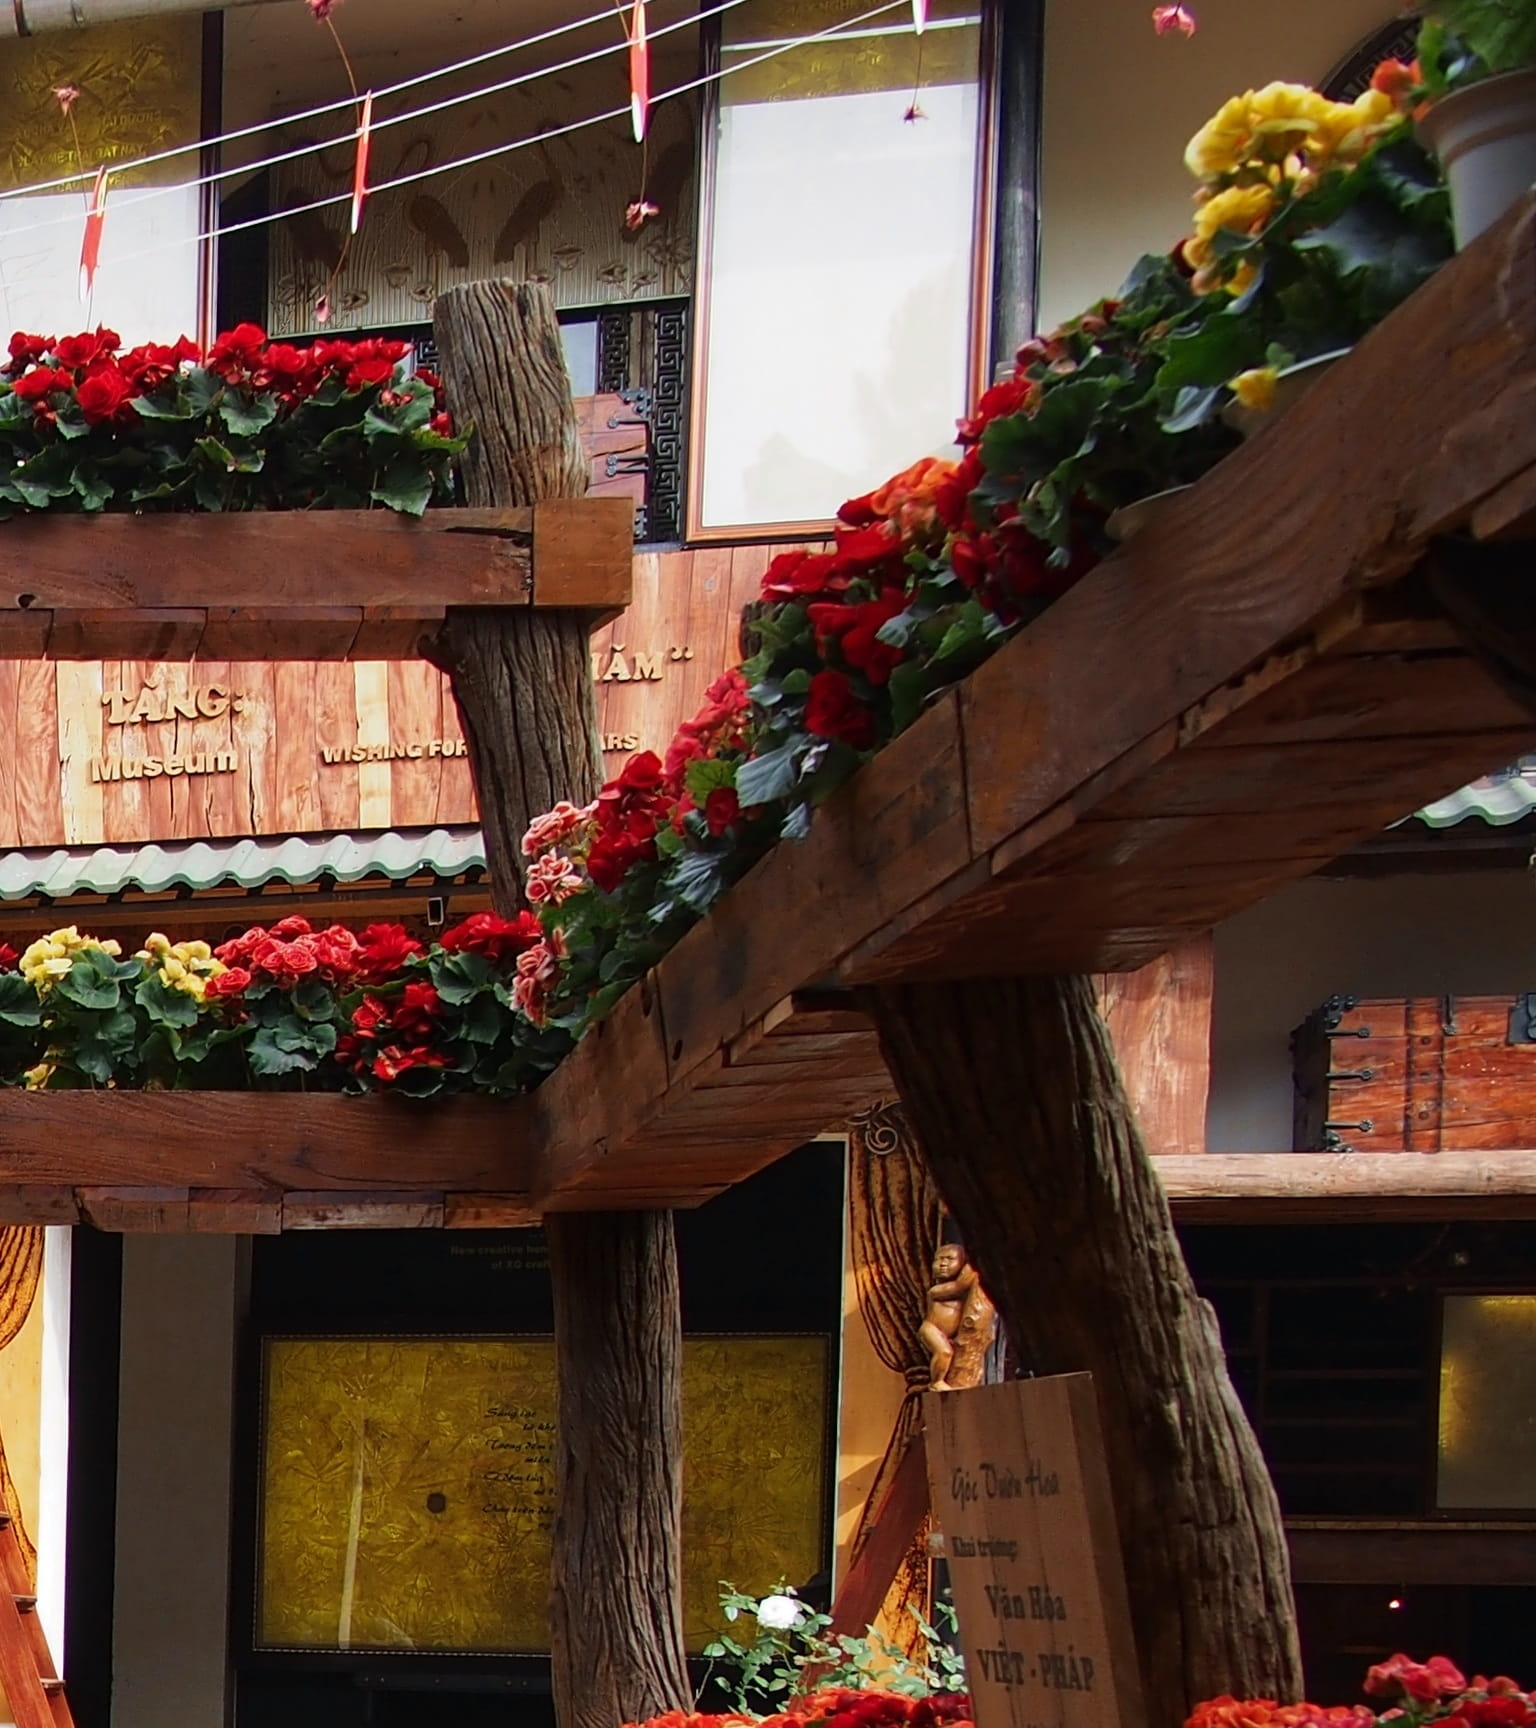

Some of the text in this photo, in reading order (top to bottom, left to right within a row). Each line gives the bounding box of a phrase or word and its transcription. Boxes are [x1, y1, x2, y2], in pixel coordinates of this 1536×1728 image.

[91, 750, 239, 783] Museum
[321, 742, 423, 764] WISHING
[984, 1584, 1026, 1619] Văn
[976, 1640, 1025, 1692] VIỆT
[1038, 1644, 1094, 1692] PHÁP
